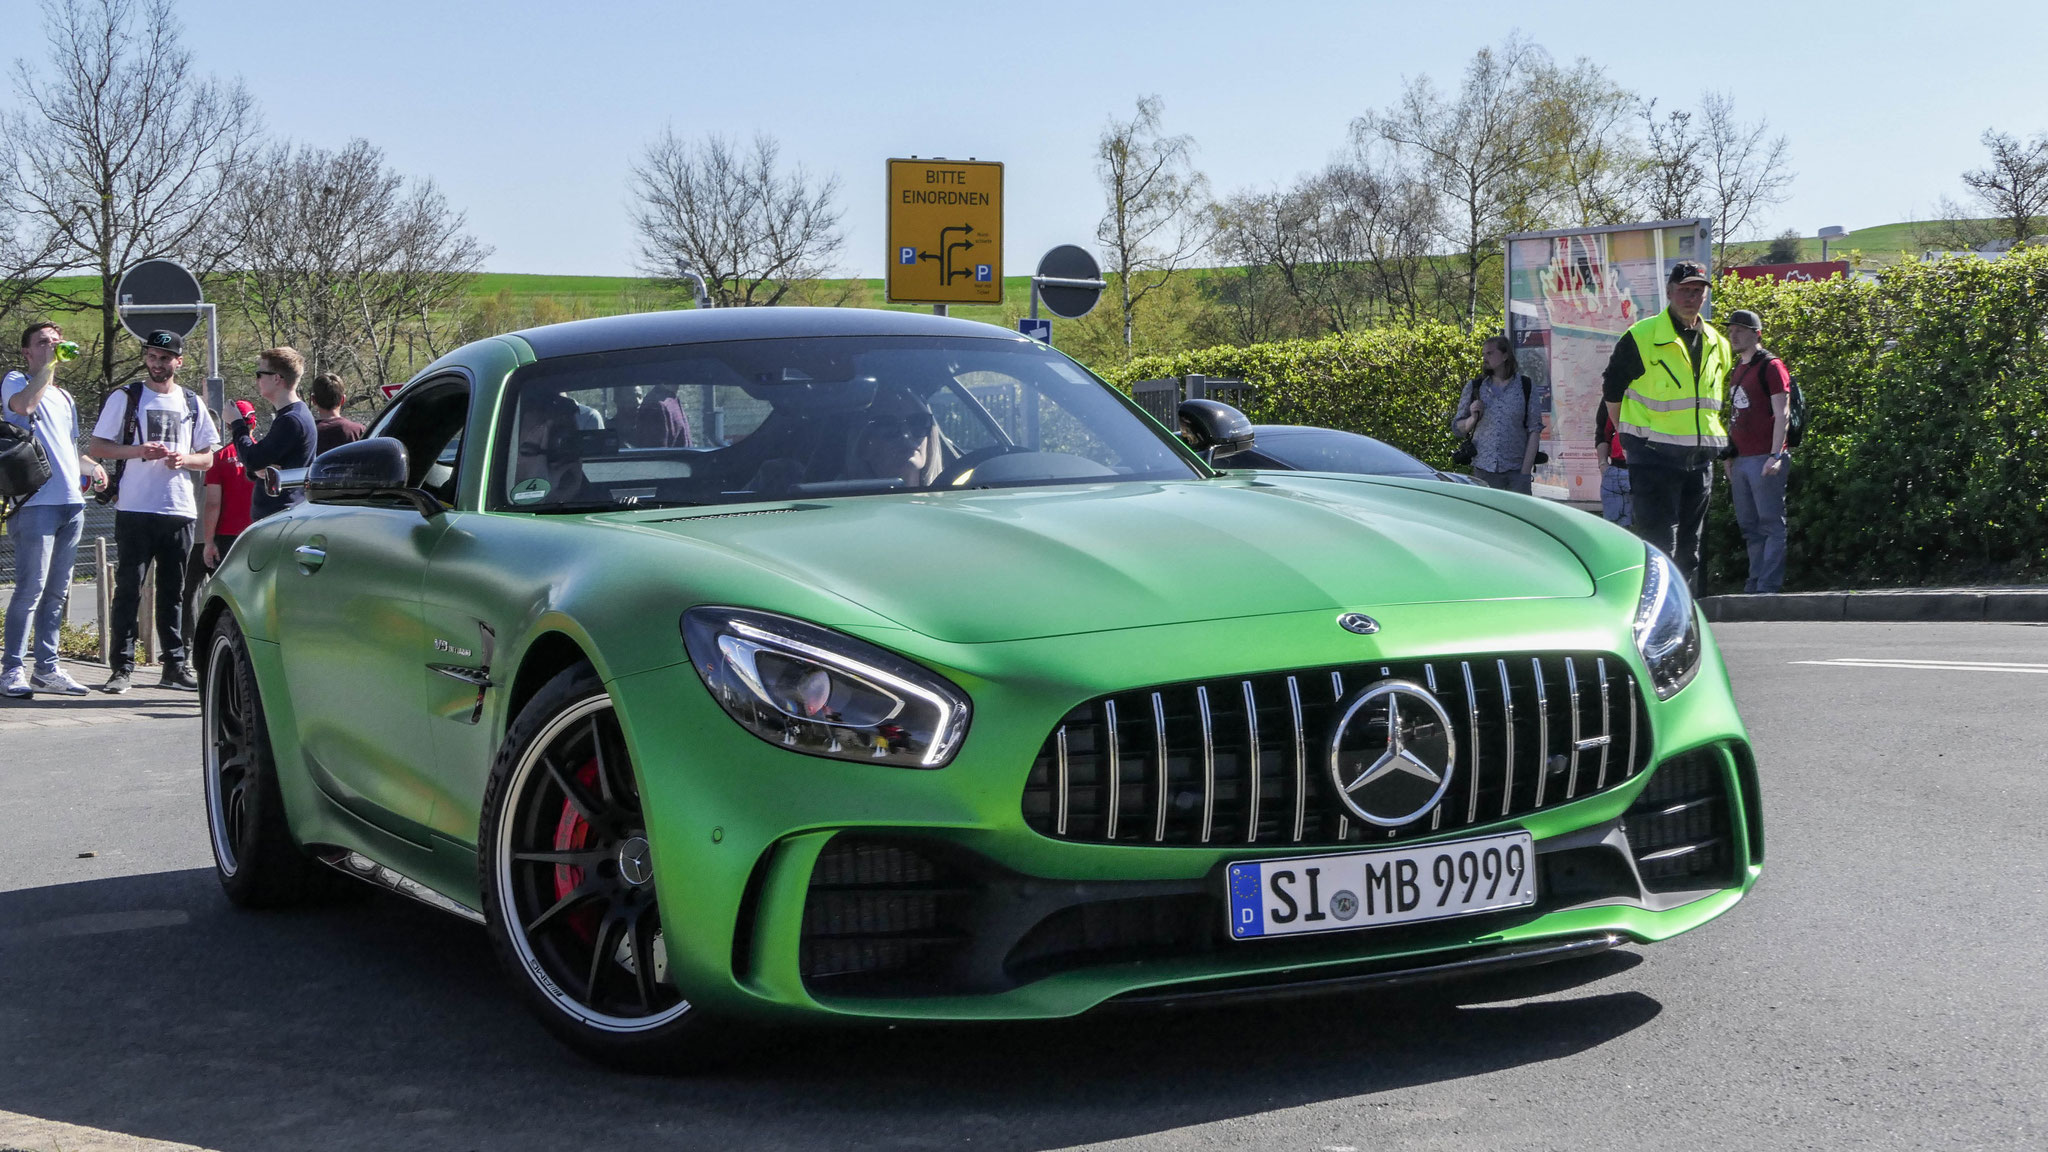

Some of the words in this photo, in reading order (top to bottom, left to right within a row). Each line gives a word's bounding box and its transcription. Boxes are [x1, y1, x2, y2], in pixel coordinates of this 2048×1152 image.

[926, 170, 966, 184] BITTE
[902, 190, 989, 206] EINORDNEN
[902, 248, 913, 264] P
[978, 265, 989, 281] P
[526, 479, 537, 491] 4
[1270, 867, 1327, 924] SI
[1365, 858, 1421, 915] MB
[1432, 844, 1525, 907] 9999
[1242, 908, 1254, 923] D
